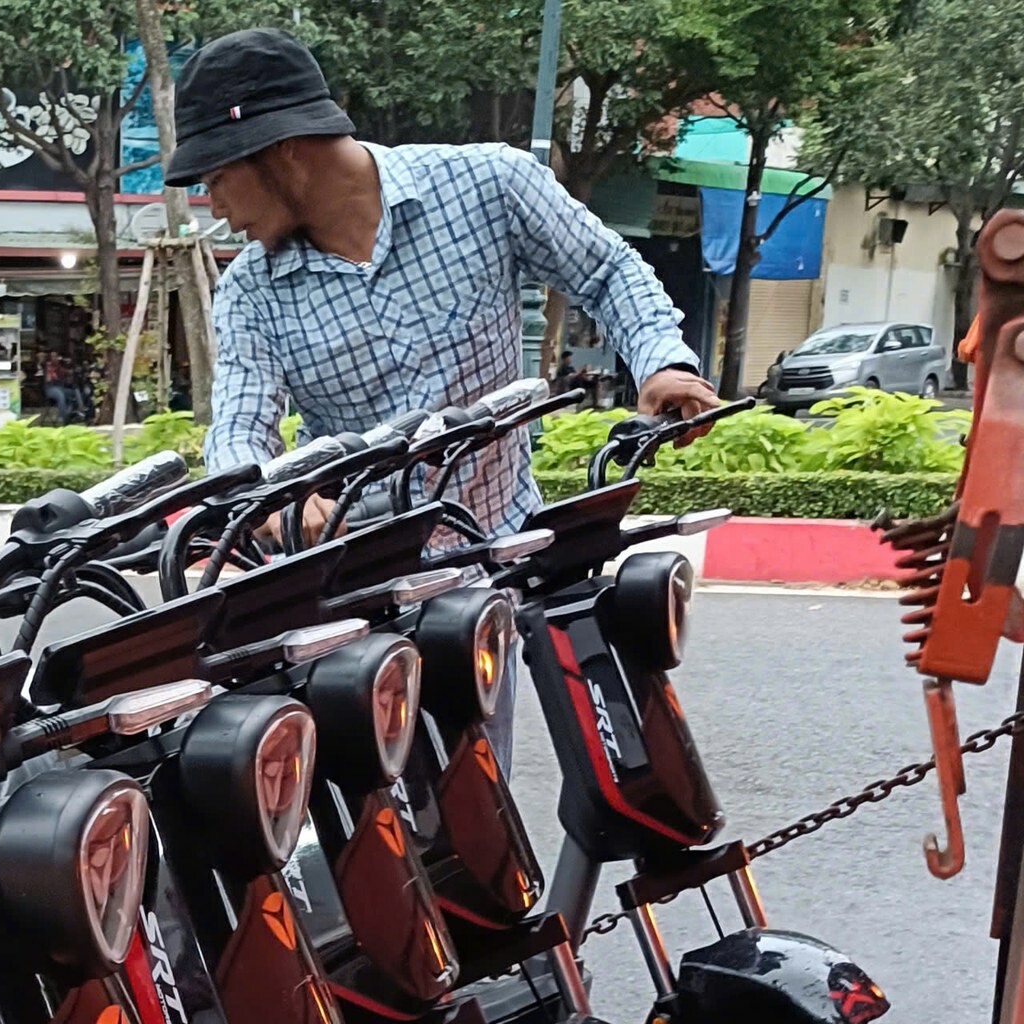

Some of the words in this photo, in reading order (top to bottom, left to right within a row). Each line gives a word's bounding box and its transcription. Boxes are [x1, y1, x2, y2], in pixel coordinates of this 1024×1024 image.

[587, 678, 622, 758] SRT
[390, 775, 418, 832] RT
[139, 904, 188, 1024] SRT
